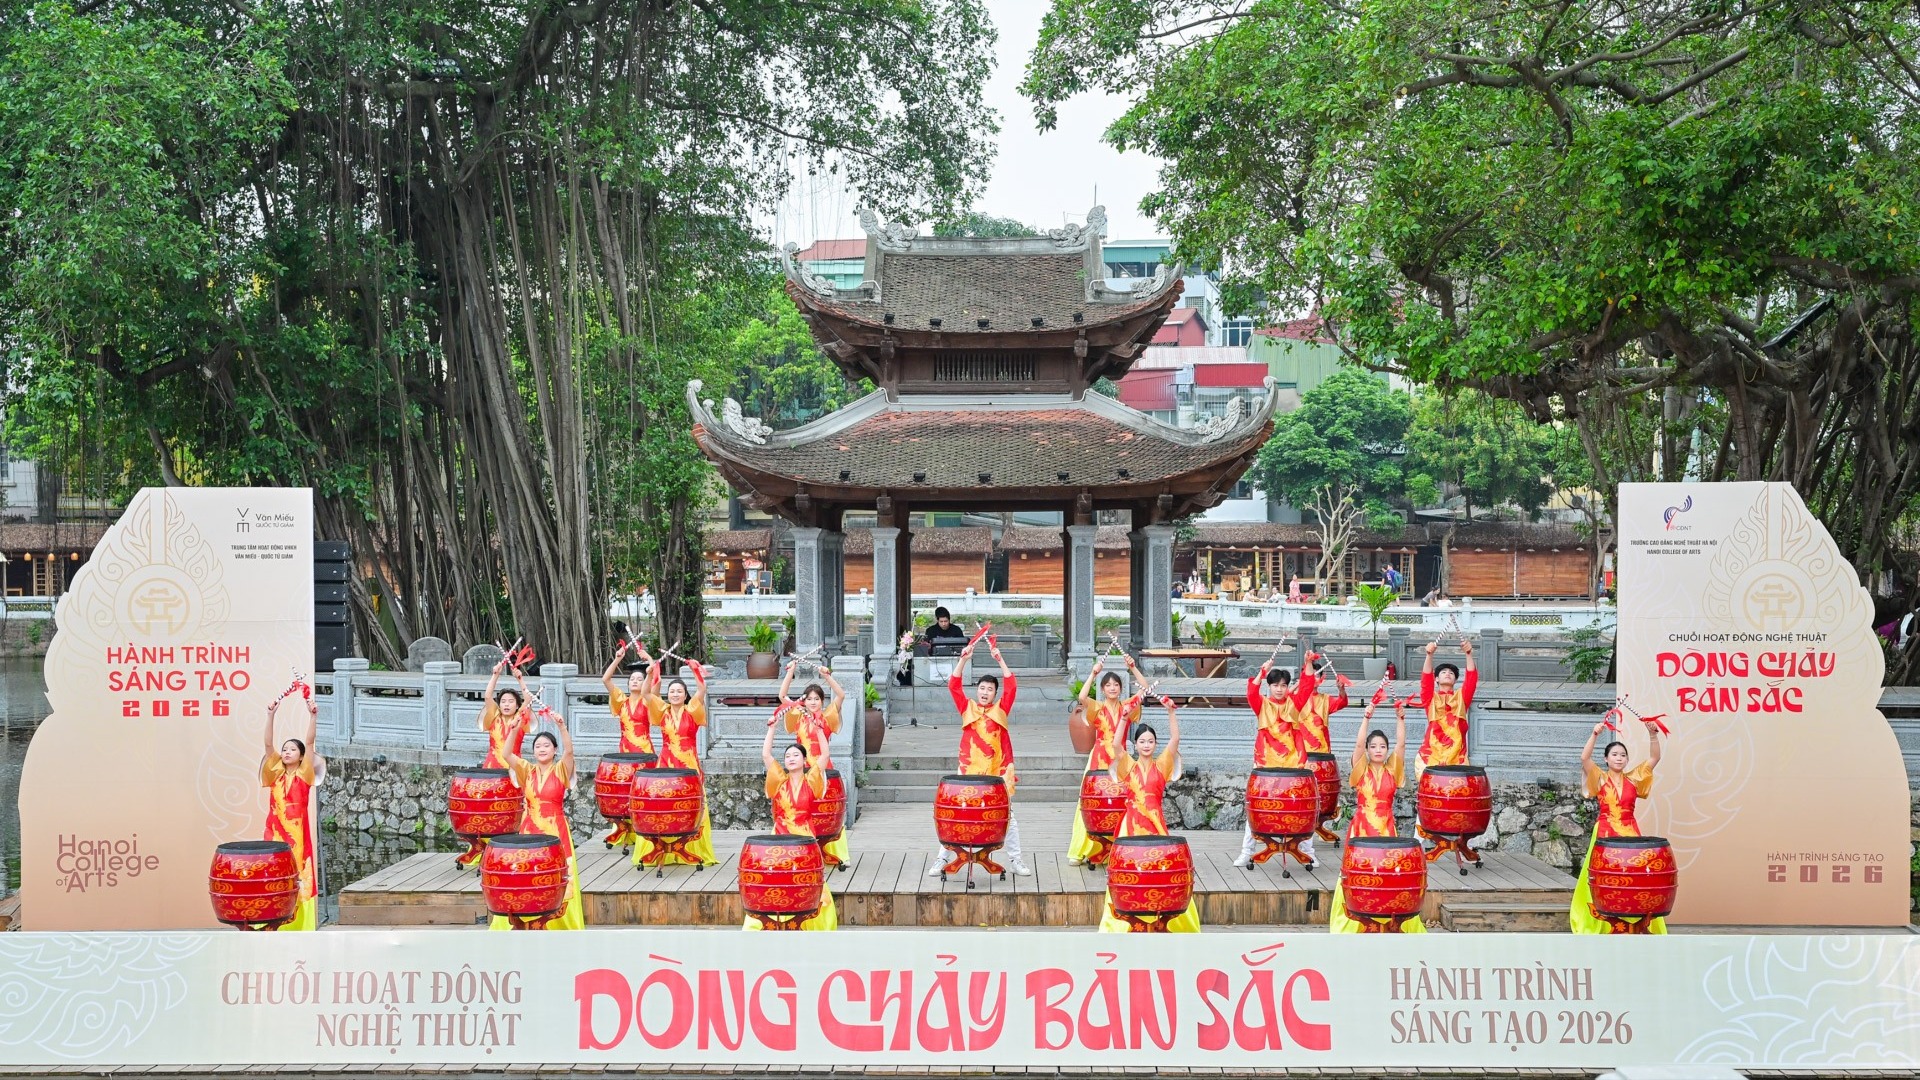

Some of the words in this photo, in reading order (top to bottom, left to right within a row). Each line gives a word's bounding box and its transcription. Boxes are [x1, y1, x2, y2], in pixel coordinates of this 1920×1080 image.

[274, 512, 295, 521] Miếu
[1710, 539, 1718, 547] NỘI
[1668, 631, 1701, 642] CHUỖI
[1703, 633, 1730, 644] HOẠT
[1732, 632, 1763, 644] ĐỘNG
[1765, 632, 1794, 644] NGHỆ
[1796, 632, 1828, 644] THUẬT
[107, 642, 174, 664] HÀNH
[181, 642, 250, 664] TRÌNH
[1656, 647, 1749, 678] DÒNG
[1756, 647, 1836, 678] CHẢY
[108, 666, 187, 692] SÁNG
[194, 669, 251, 697] TẠO
[122, 699, 230, 717] 2026
[1676, 682, 1740, 713] BẢN
[1747, 679, 1803, 713] SẮC
[58, 833, 138, 855] Hanoi
[1767, 850, 1797, 862] HÀNH
[1799, 850, 1829, 862] TRÌNH
[1831, 851, 1861, 862] SÁNG
[1862, 853, 1885, 864] TẠO
[56, 848, 160, 877] College
[1767, 864, 1883, 883] 2026
[56, 875, 68, 886] of
[66, 867, 118, 893] Arts
[221, 959, 323, 1005] CHUỖI
[331, 971, 422, 1010] HOẠT
[429, 963, 522, 1012] ĐỘNG
[1389, 960, 1483, 1001] HÀNH
[1491, 960, 1595, 1001] TRÌNH
[574, 953, 798, 1052] DÒNG
[817, 954, 1008, 1053] CHẢY
[1025, 952, 1178, 1051] BẢN
[1196, 942, 1332, 1052] SẮC
[315, 1006, 402, 1055] NGHỆ
[411, 1006, 522, 1055] THUẬT
[1390, 1003, 1473, 1044] SÁNG
[1481, 1010, 1548, 1053] TẠO
[1557, 1010, 1633, 1045] 2026
